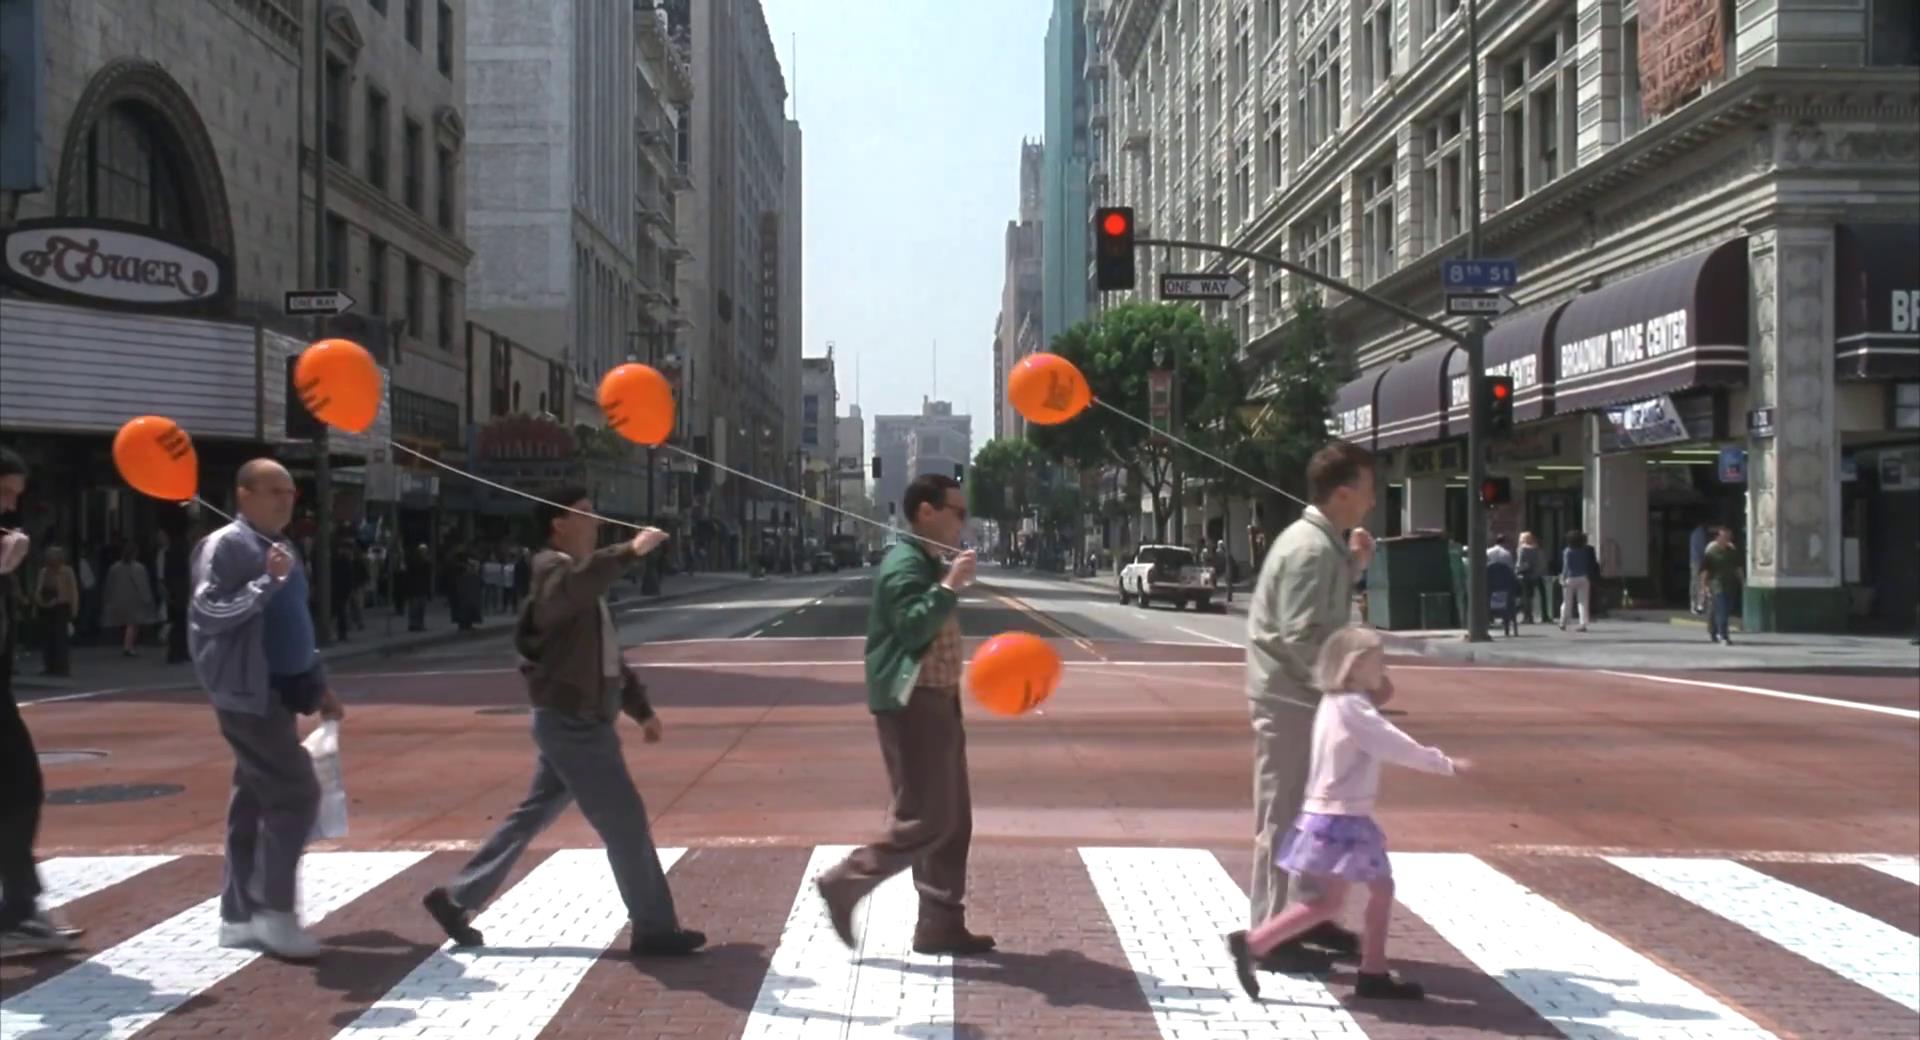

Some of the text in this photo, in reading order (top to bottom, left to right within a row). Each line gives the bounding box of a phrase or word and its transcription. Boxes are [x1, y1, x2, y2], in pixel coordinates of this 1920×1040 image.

[1167, 281, 1228, 293] ONE WAY
[1561, 309, 1687, 378] BROADWAY TRADE CENTER
